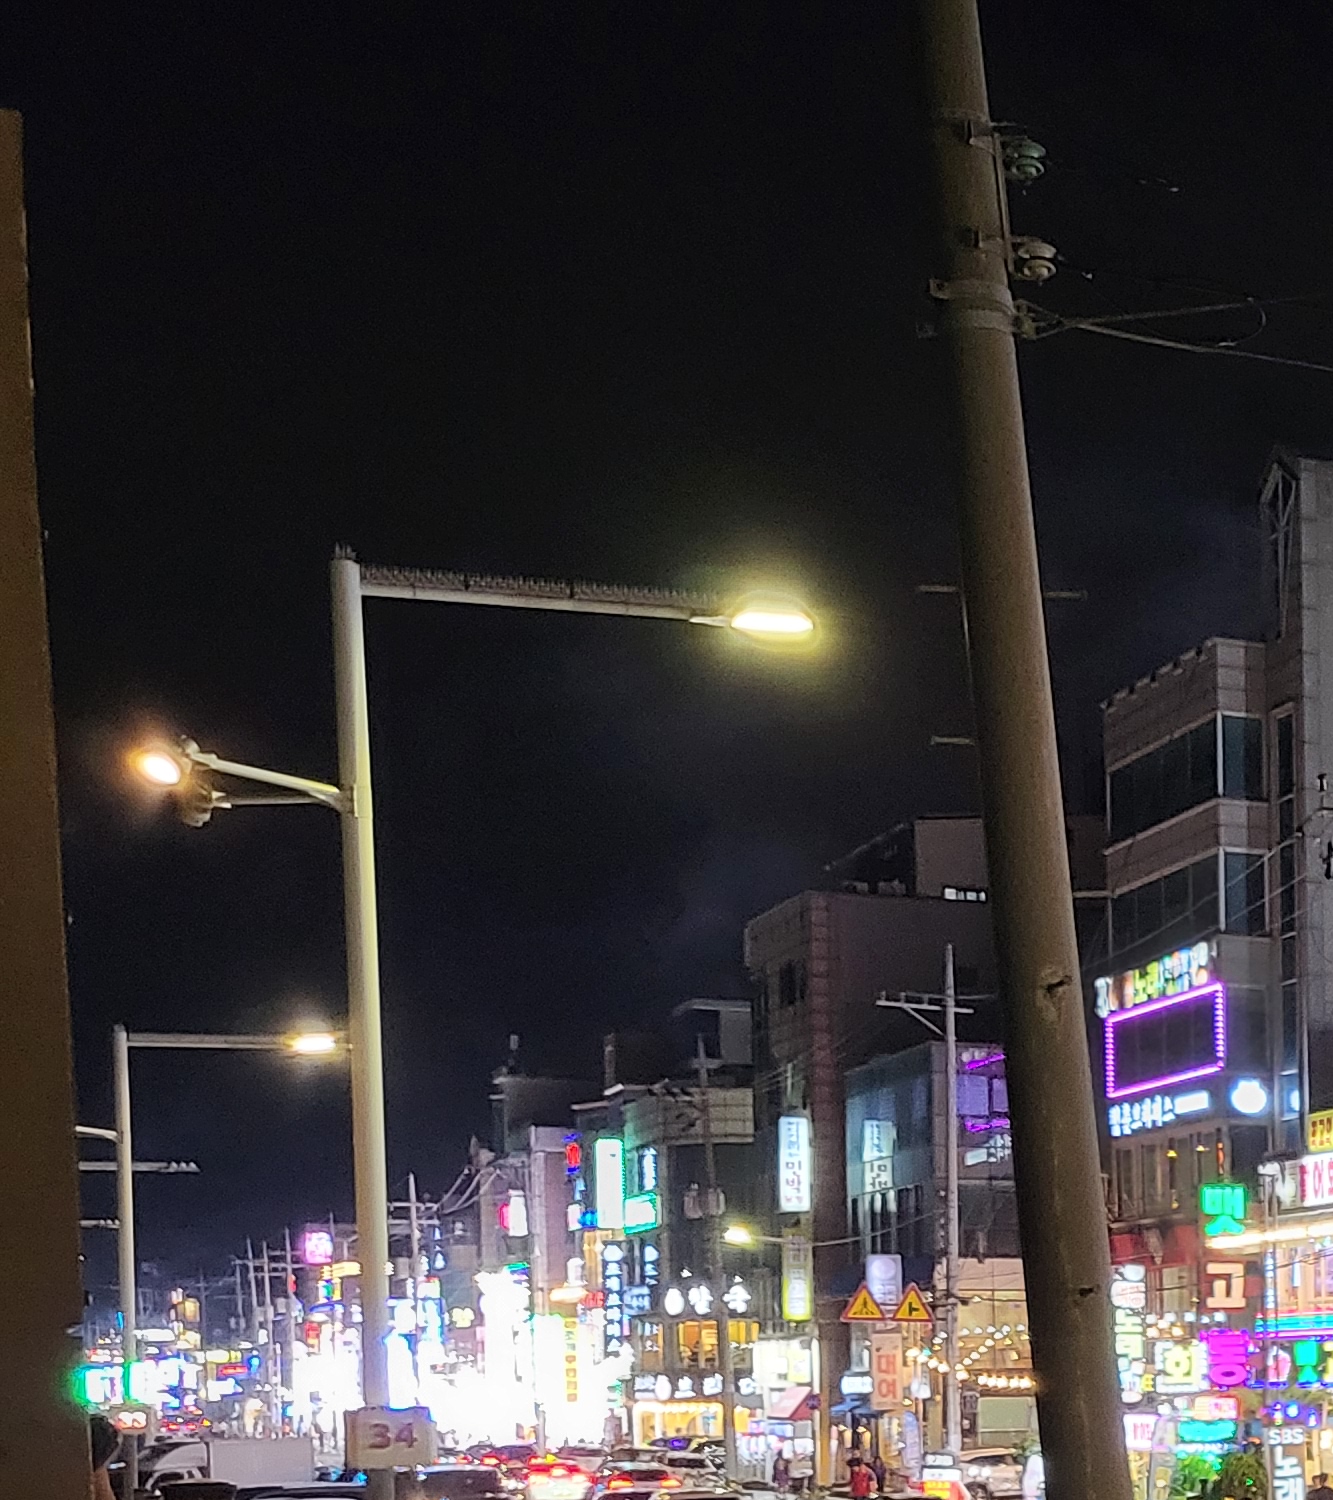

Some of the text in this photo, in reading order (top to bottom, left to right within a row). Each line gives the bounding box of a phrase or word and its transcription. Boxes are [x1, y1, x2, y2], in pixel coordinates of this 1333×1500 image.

[876, 1353, 897, 1400] 대여
[368, 1423, 417, 1449] 34
[1269, 1429, 1304, 1444] SBS
